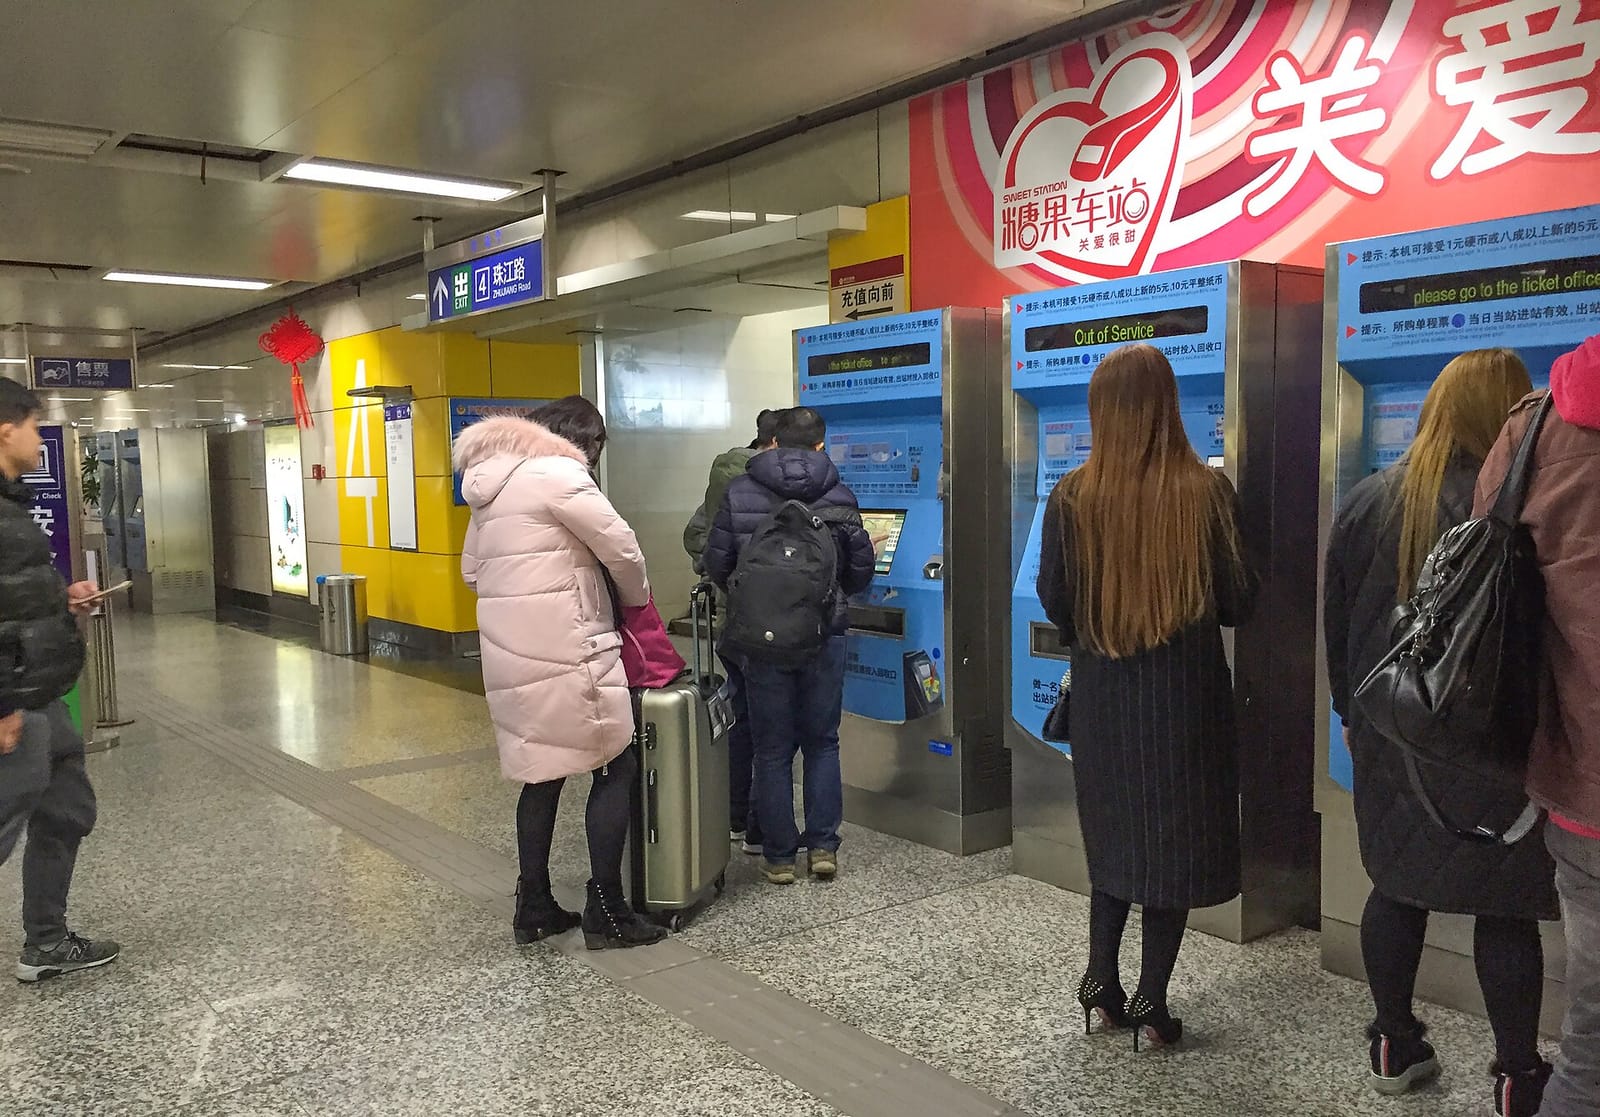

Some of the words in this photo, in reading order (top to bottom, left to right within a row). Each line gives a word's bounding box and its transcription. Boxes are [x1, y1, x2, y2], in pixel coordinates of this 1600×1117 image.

[1003, 189, 1032, 204] SWEET
[1033, 180, 1068, 198] STATION
[1002, 177, 1150, 251] 糖果车站
[1078, 229, 1136, 252] 关爱很甜
[492, 256, 526, 286] 珠江路
[454, 272, 469, 297] 出
[492, 284, 518, 299] ZHUJIANG
[518, 281, 532, 292] Road
[841, 282, 894, 309] 充值向前
[1414, 288, 1456, 307] please
[1460, 286, 1477, 300] go
[1480, 282, 1493, 297] to
[1496, 280, 1518, 296] the
[1522, 274, 1560, 293] ticket
[1563, 269, 1600, 289] office
[455, 296, 469, 310] EXIT
[1074, 328, 1094, 346] Out
[1097, 326, 1109, 343] of
[1111, 322, 1154, 341] Service
[75, 361, 110, 377] 售票
[42, 492, 62, 500] Check
